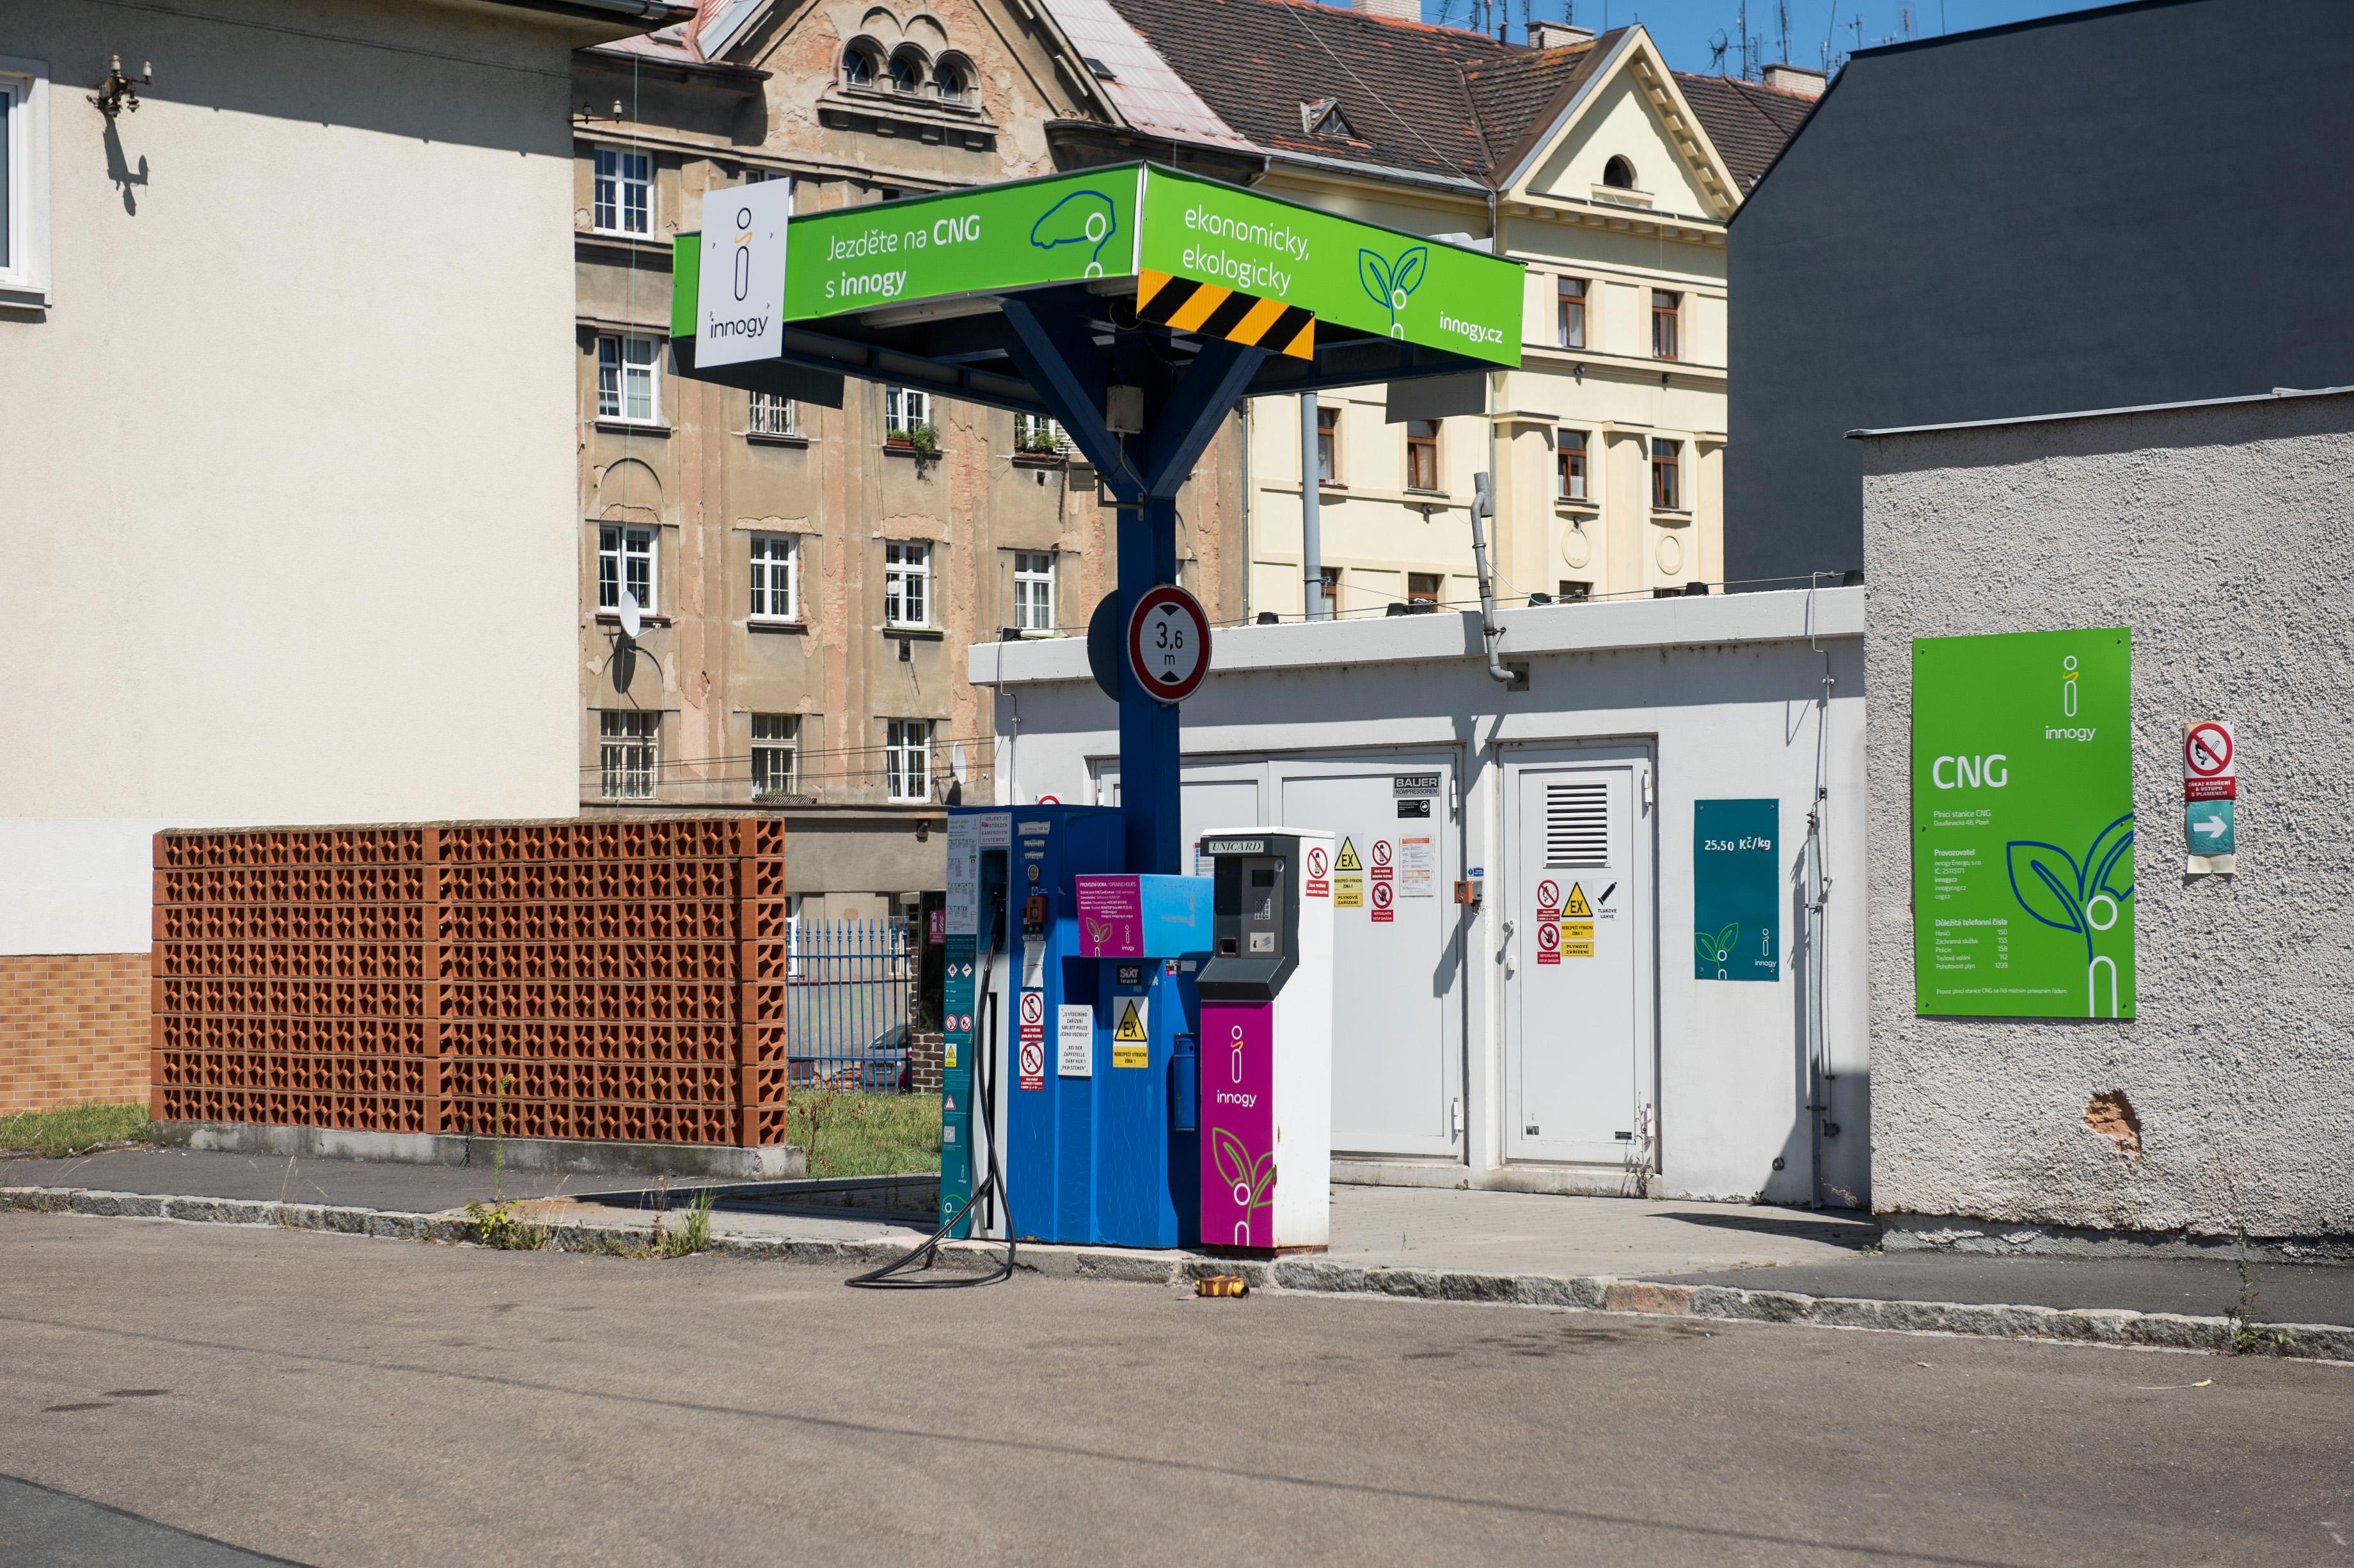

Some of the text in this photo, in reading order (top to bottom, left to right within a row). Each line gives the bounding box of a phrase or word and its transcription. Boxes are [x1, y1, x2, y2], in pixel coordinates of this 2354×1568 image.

[827, 214, 981, 261] Jezděte na CNG
[1185, 203, 1309, 261] ekonomicky,
[1182, 244, 1291, 296] ekologicky
[825, 269, 907, 299] s innogy
[709, 315, 769, 338] innogy
[1439, 310, 1503, 344] innogy.cz
[1156, 621, 1183, 651] 3,6
[1164, 654, 1175, 665] m
[2045, 725, 2096, 741] innogy
[1932, 754, 2008, 789] CNG
[1396, 777, 1437, 788] BAUER
[1212, 842, 1261, 851] UNICARD
[1705, 837, 1771, 851] 25,50 Kč/kg
[1341, 854, 1354, 867] EX
[1570, 900, 1583, 914] EX
[1755, 959, 1776, 967] innogy
[1124, 1021, 1137, 1038] EX
[1217, 1089, 1257, 1107] innogy
